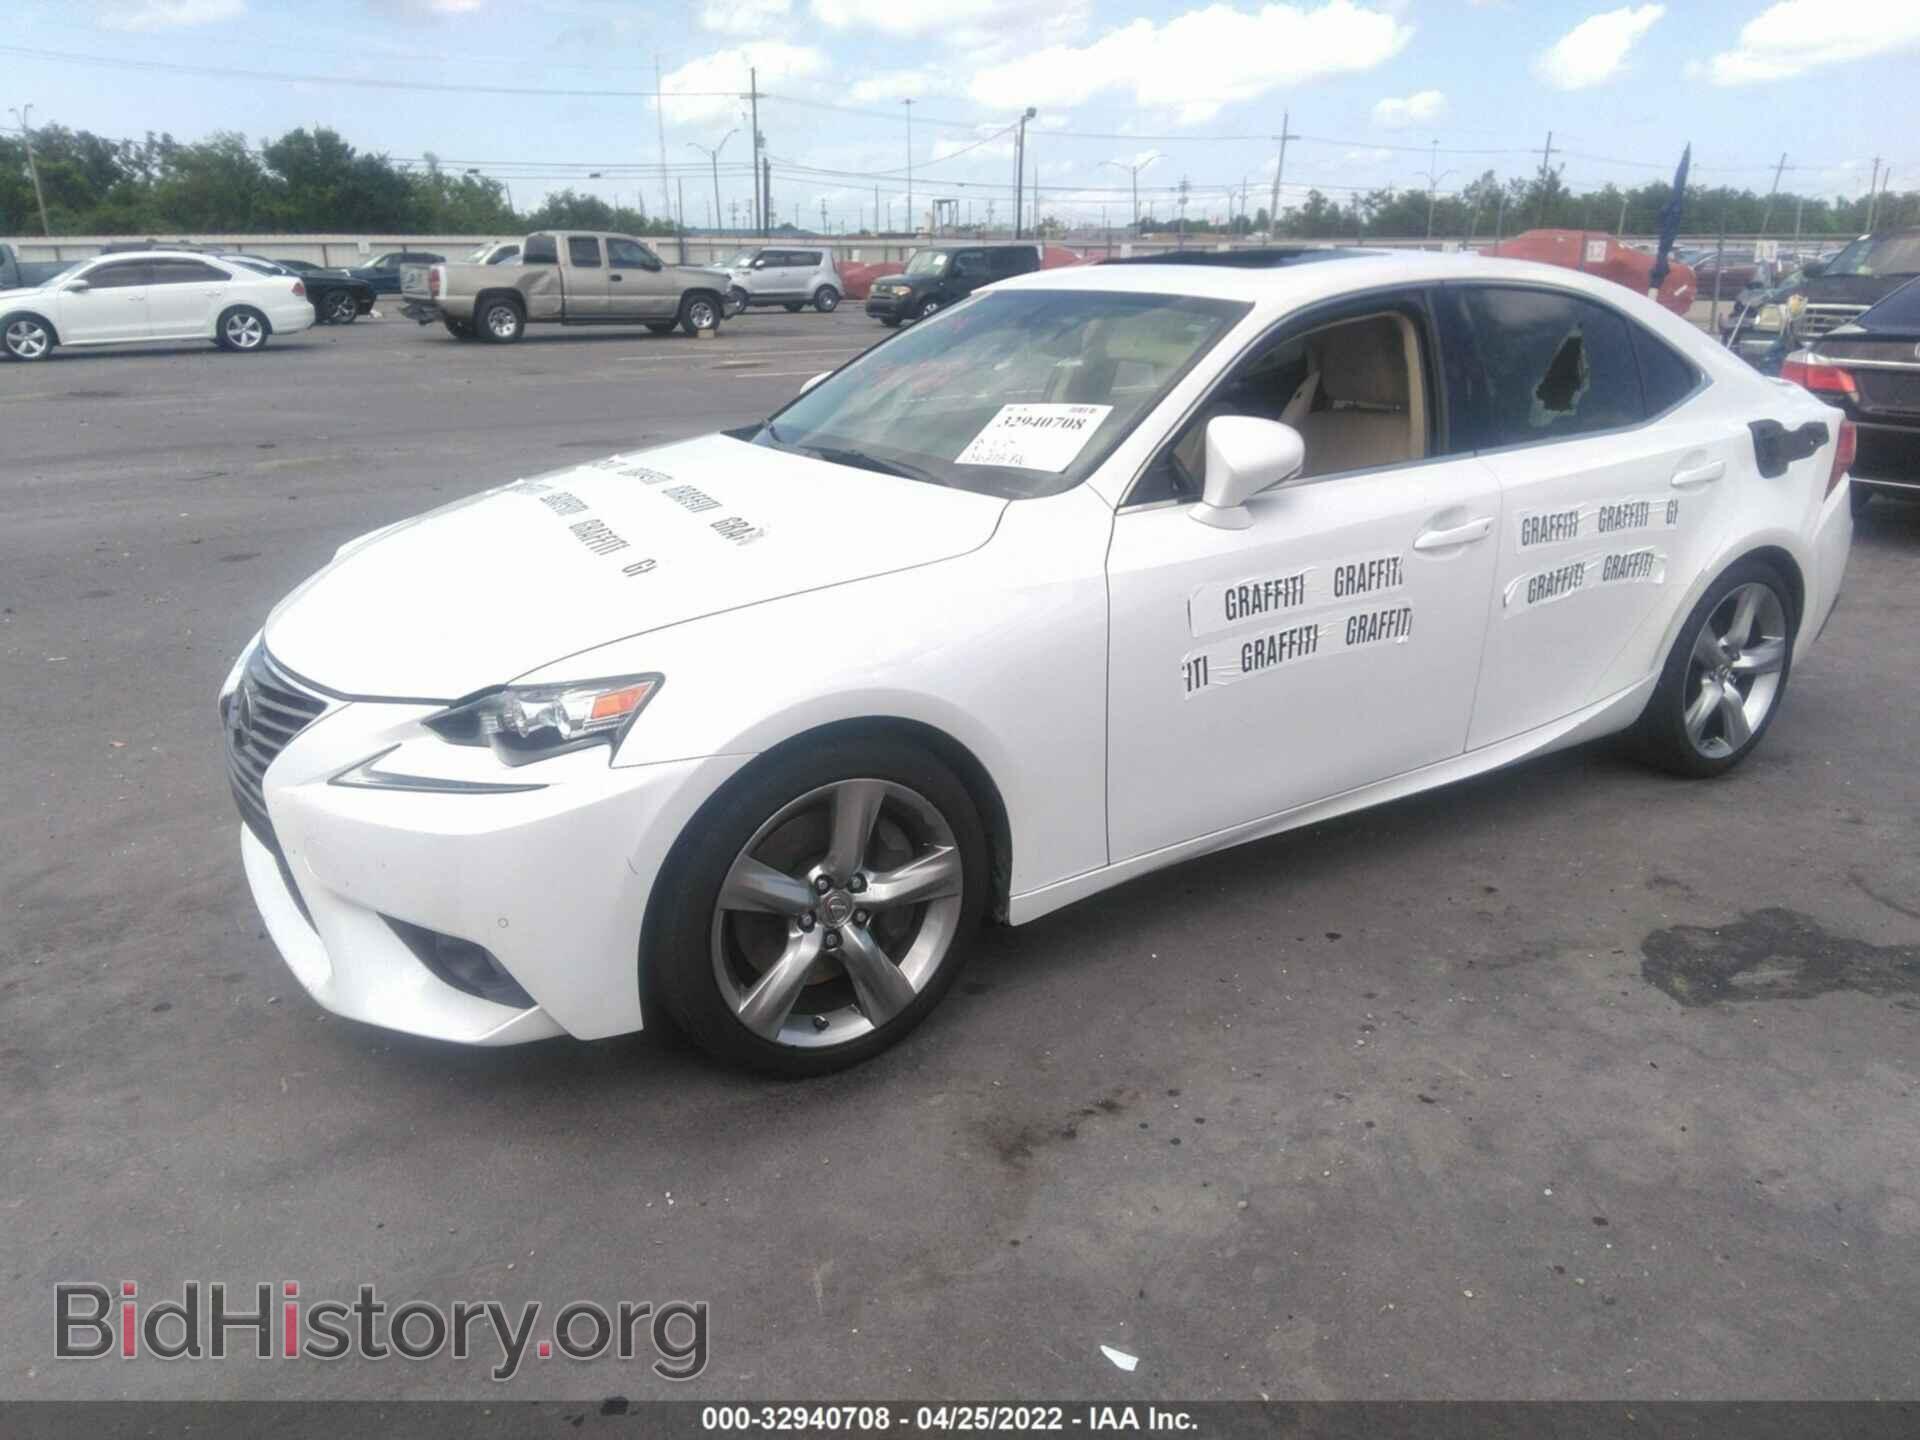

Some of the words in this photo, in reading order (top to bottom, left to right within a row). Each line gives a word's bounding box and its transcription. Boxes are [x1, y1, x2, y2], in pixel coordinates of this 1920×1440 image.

[1521, 510, 1578, 546] GRAFFITI
[1598, 502, 1649, 532] GRAFFITI
[1225, 574, 1304, 621] GRAFFITI
[1527, 562, 1585, 604] GRAFFITI
[1603, 552, 1654, 581] GRAFFITI
[1182, 655, 1208, 692] ITI
[1241, 624, 1318, 672] GRAFFITI
